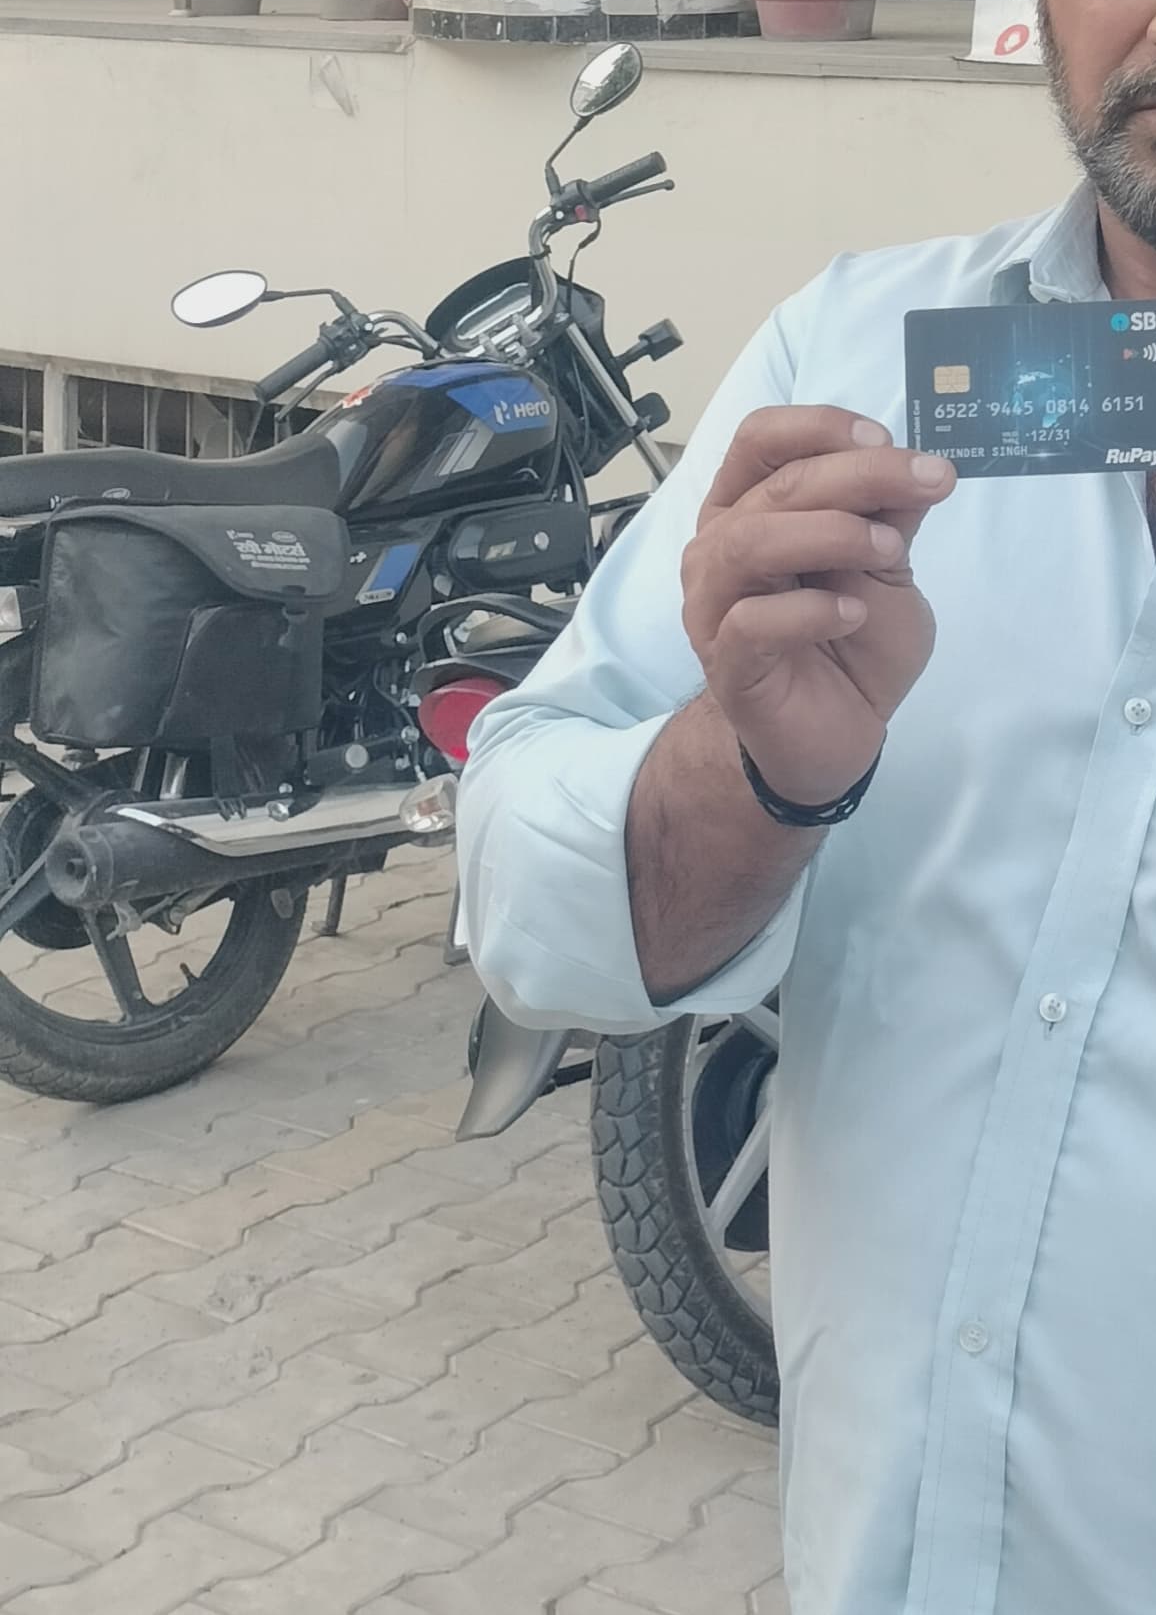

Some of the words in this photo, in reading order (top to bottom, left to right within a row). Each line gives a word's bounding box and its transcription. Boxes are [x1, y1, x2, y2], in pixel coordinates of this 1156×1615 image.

[513, 400, 551, 418] Hero
[934, 402, 978, 419] 6522
[989, 400, 1034, 417] 9445
[1046, 399, 1090, 415] 0814
[1101, 396, 1145, 412] 6151
[1031, 428, 1071, 442] 12/31
[992, 445, 1029, 458] SINGH
